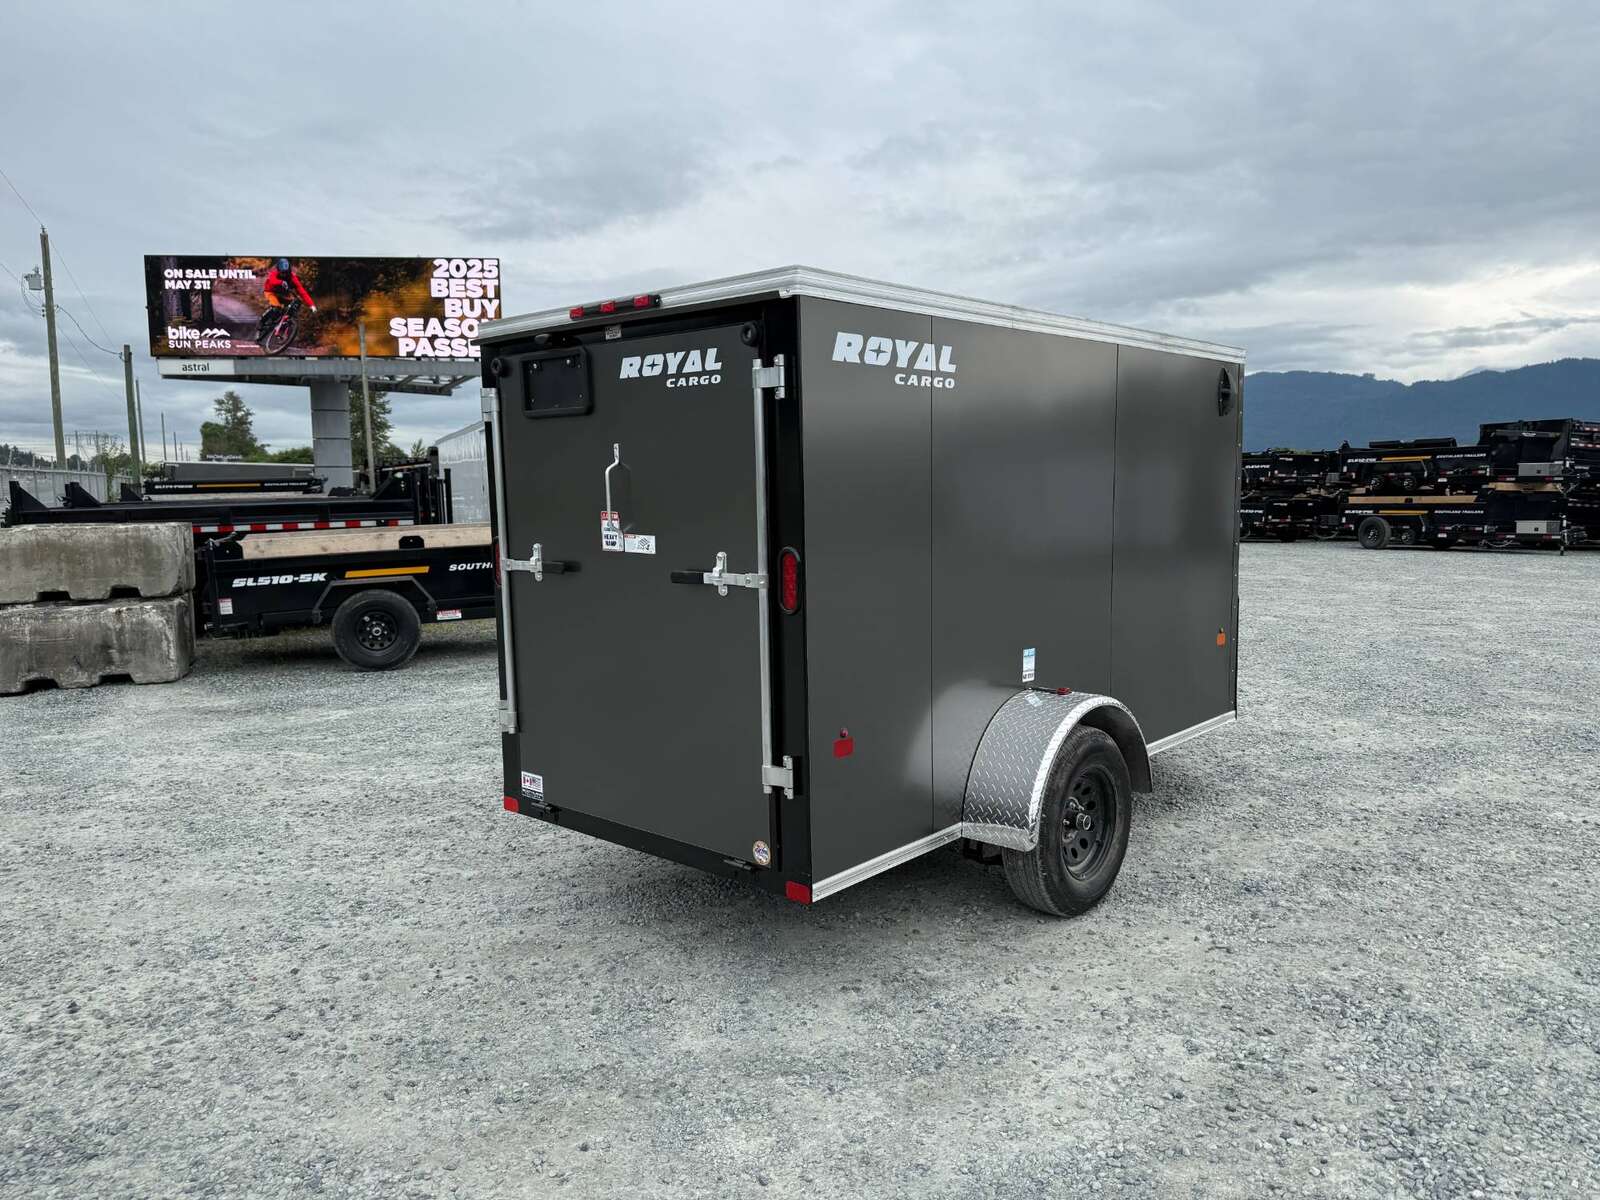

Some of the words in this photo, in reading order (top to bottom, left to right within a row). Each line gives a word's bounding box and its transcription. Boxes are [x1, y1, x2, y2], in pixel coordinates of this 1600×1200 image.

[163, 268, 183, 279] ON
[185, 268, 218, 279] SALE
[219, 269, 257, 279] UNTIL
[432, 258, 499, 279] 2025
[164, 280, 192, 290] MAY
[193, 280, 211, 290] 31!
[430, 278, 499, 298] BEST
[444, 298, 500, 319] BUY
[167, 326, 201, 340] bike
[389, 317, 487, 338] SEASO
[168, 340, 191, 349] SUN
[195, 340, 232, 349] PEAKS
[832, 331, 957, 374] ROYAL
[182, 361, 210, 373] astral
[619, 347, 723, 380] ROYAL
[666, 374, 722, 388] CARGO
[894, 373, 956, 389] CARGO
